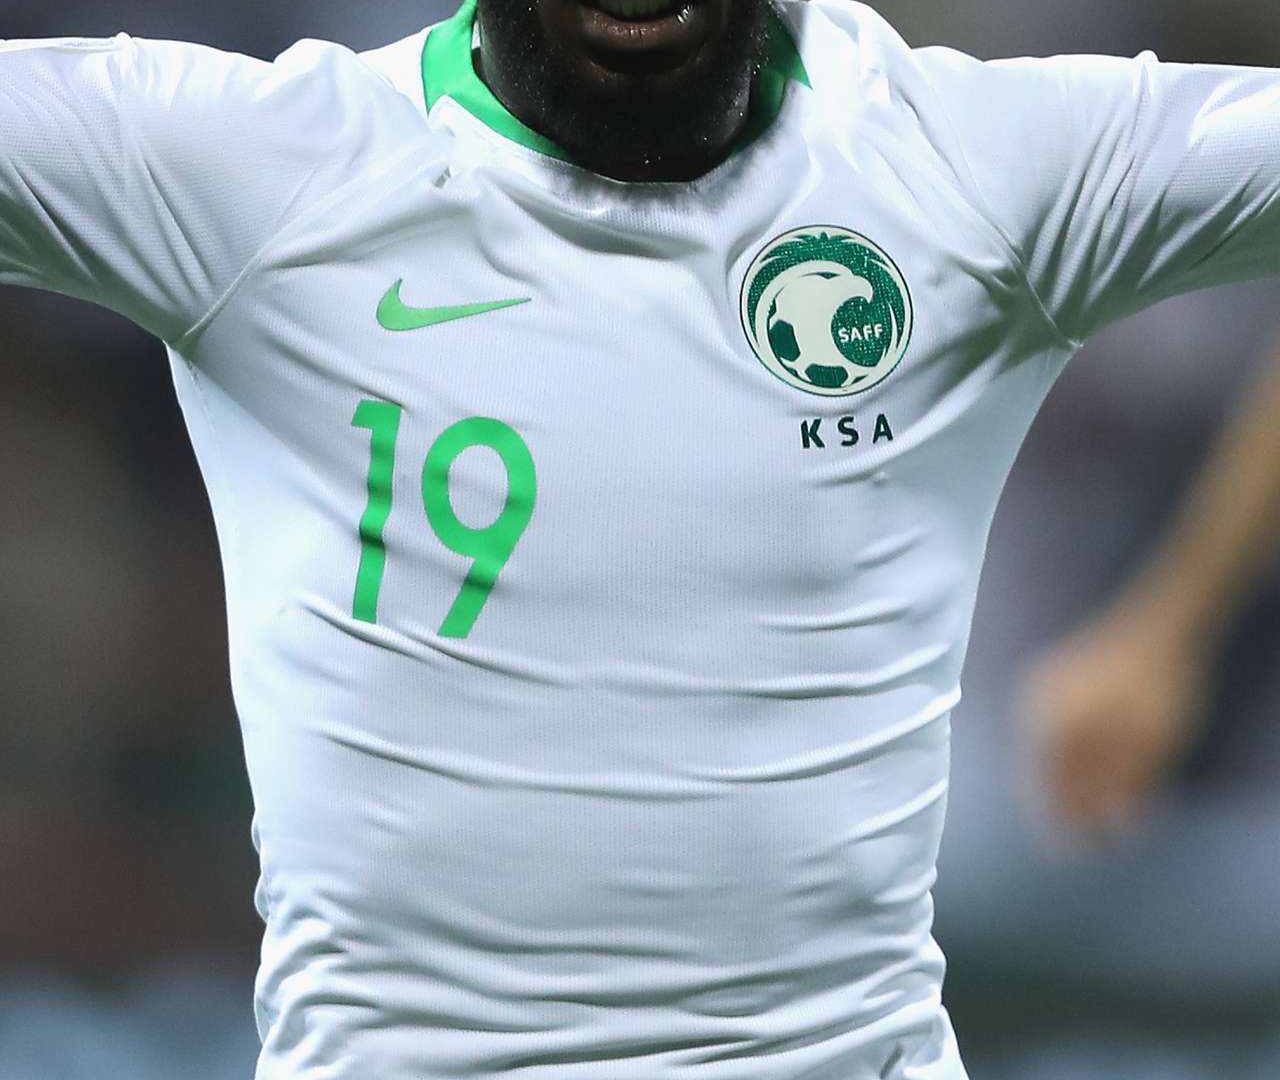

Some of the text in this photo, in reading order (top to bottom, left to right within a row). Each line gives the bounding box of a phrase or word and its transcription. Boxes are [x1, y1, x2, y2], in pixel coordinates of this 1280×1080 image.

[838, 323, 883, 343] SAFF
[800, 413, 893, 448] KSA
[351, 398, 537, 638] 19
